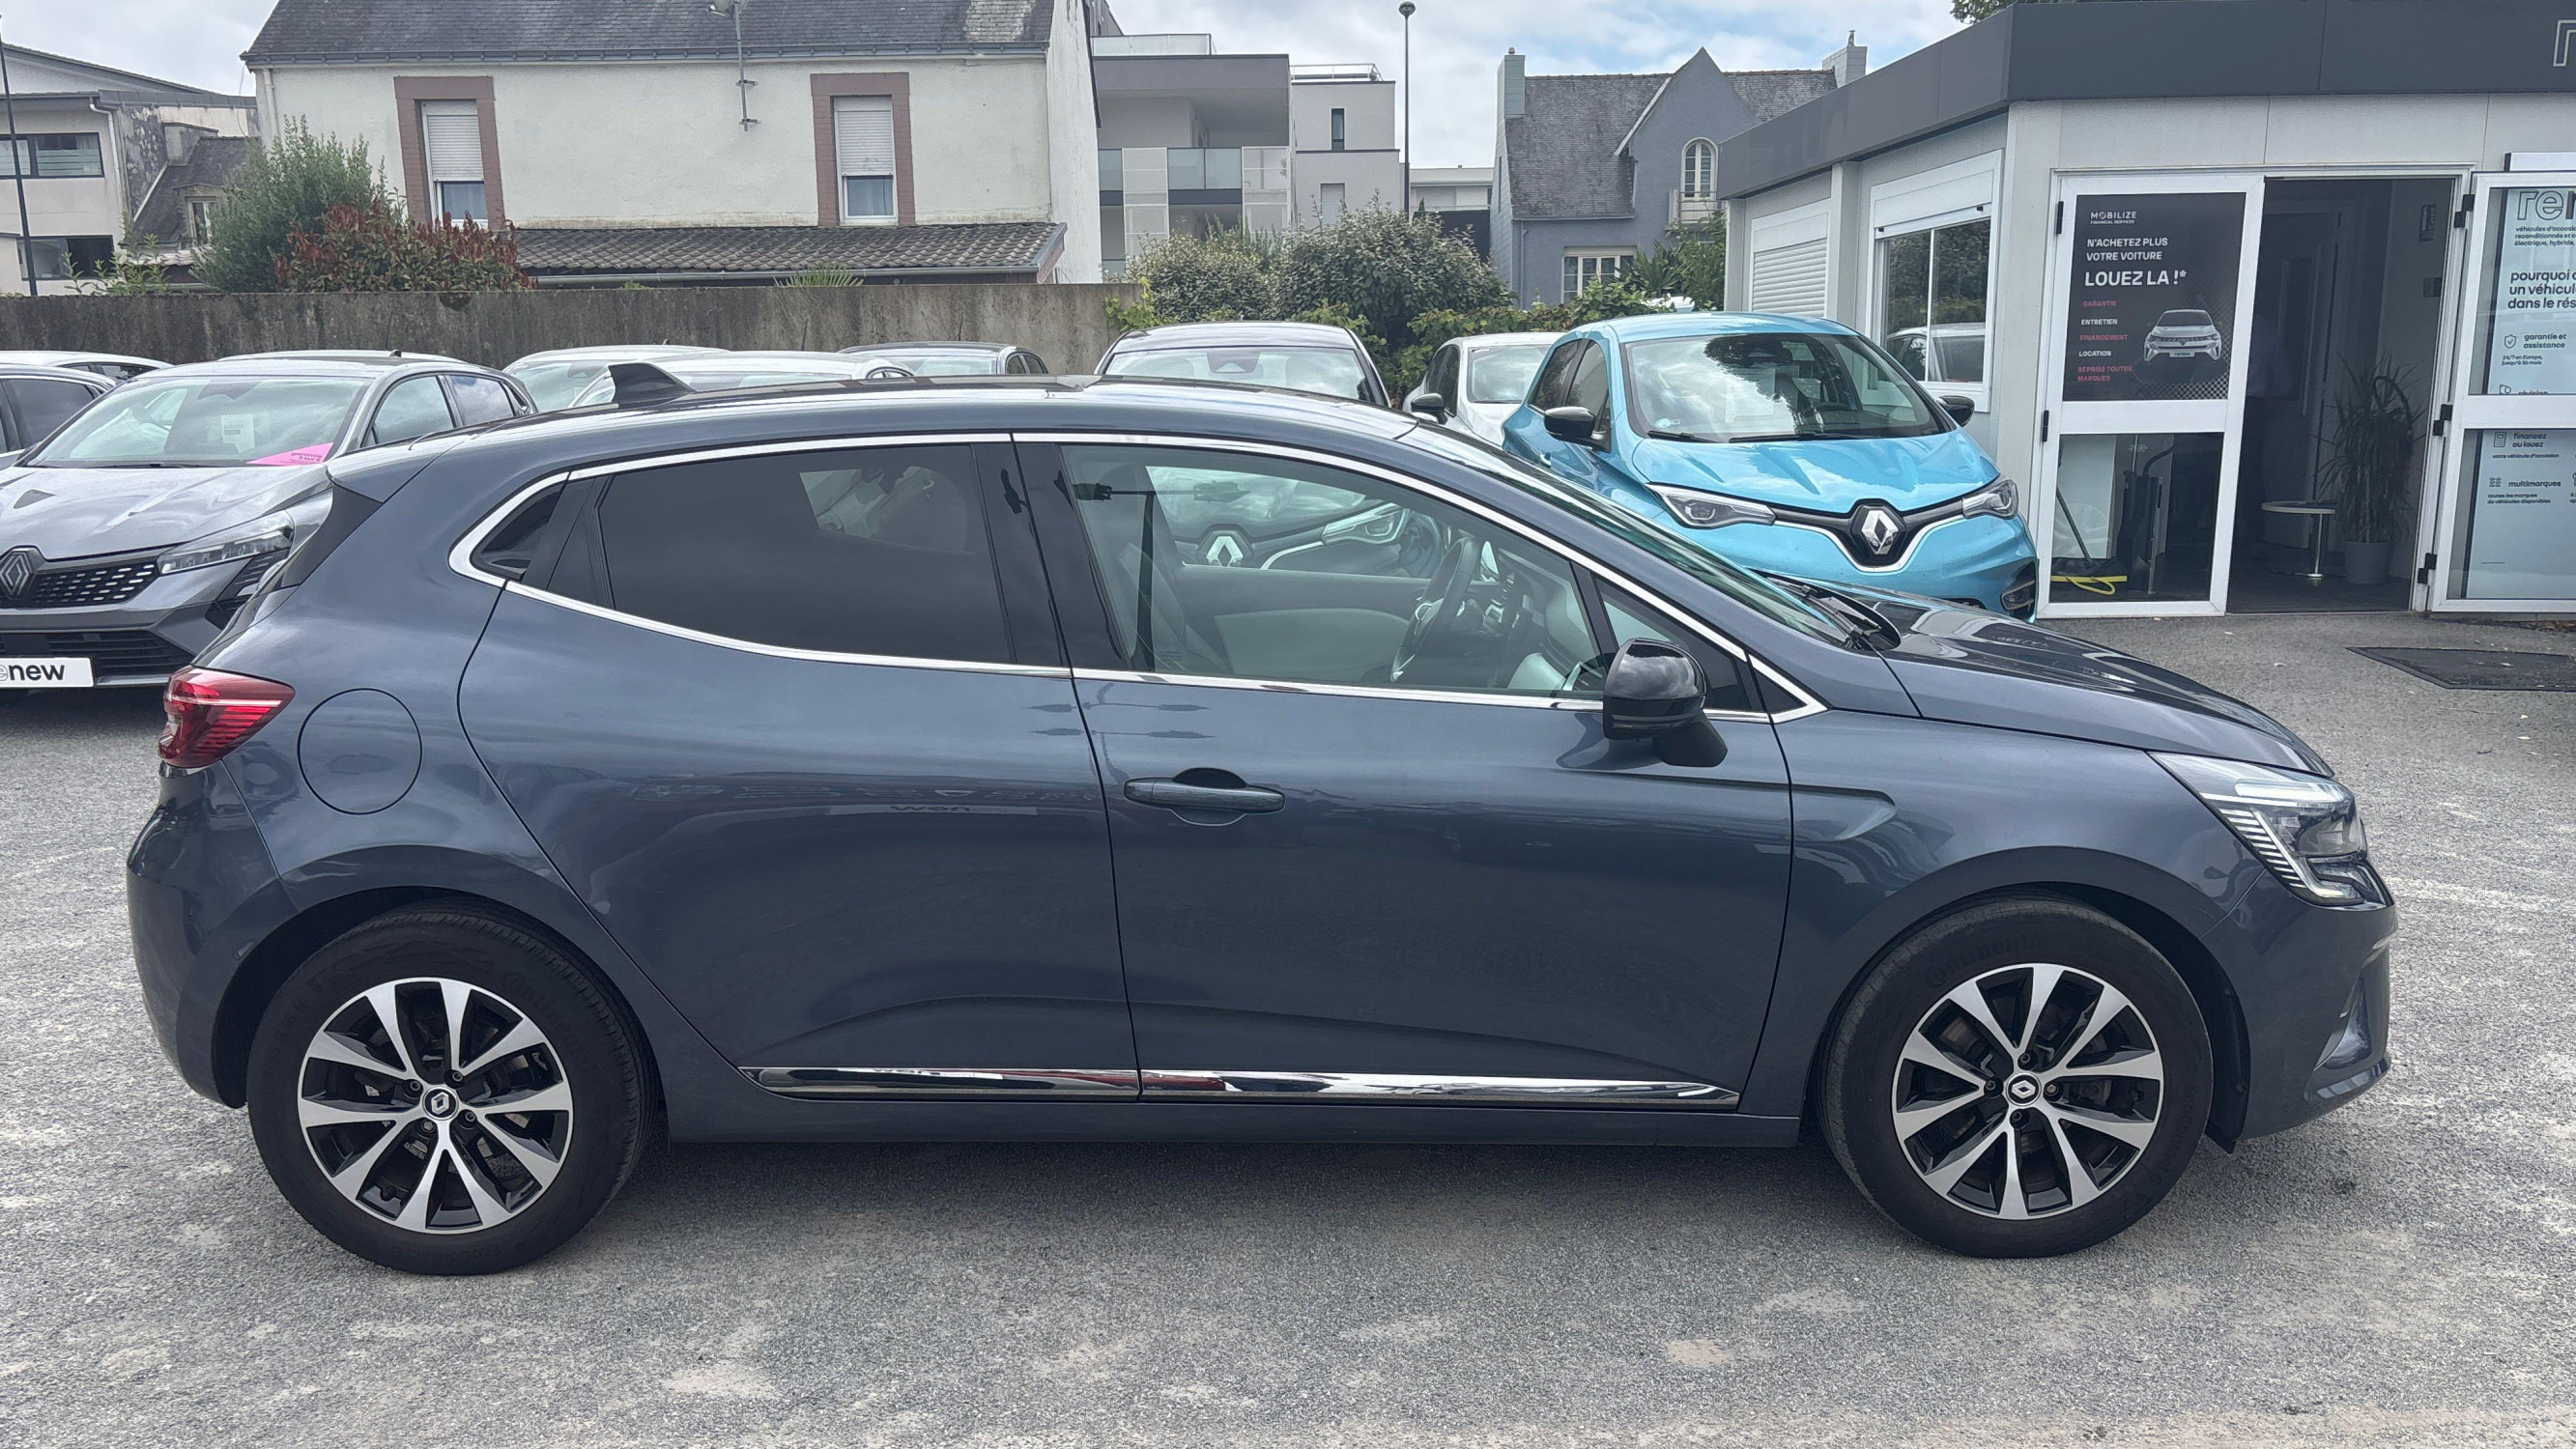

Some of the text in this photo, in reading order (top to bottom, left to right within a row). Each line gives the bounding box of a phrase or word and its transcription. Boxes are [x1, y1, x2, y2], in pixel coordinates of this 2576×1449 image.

[2090, 211, 2137, 220] MOBILIZE
[2087, 237, 2168, 247] N'ACHETEZ PLUS
[2086, 251, 2163, 261] VOTRE VOITURE
[2084, 270, 2144, 287] LOUEZ
[2146, 270, 2170, 286] LA
[2510, 269, 2570, 284] pourquoi
[2509, 282, 2576, 296] un véhicul
[2507, 297, 2541, 309] dans
[2542, 297, 2555, 309] le
[2524, 333, 2558, 342] garantie
